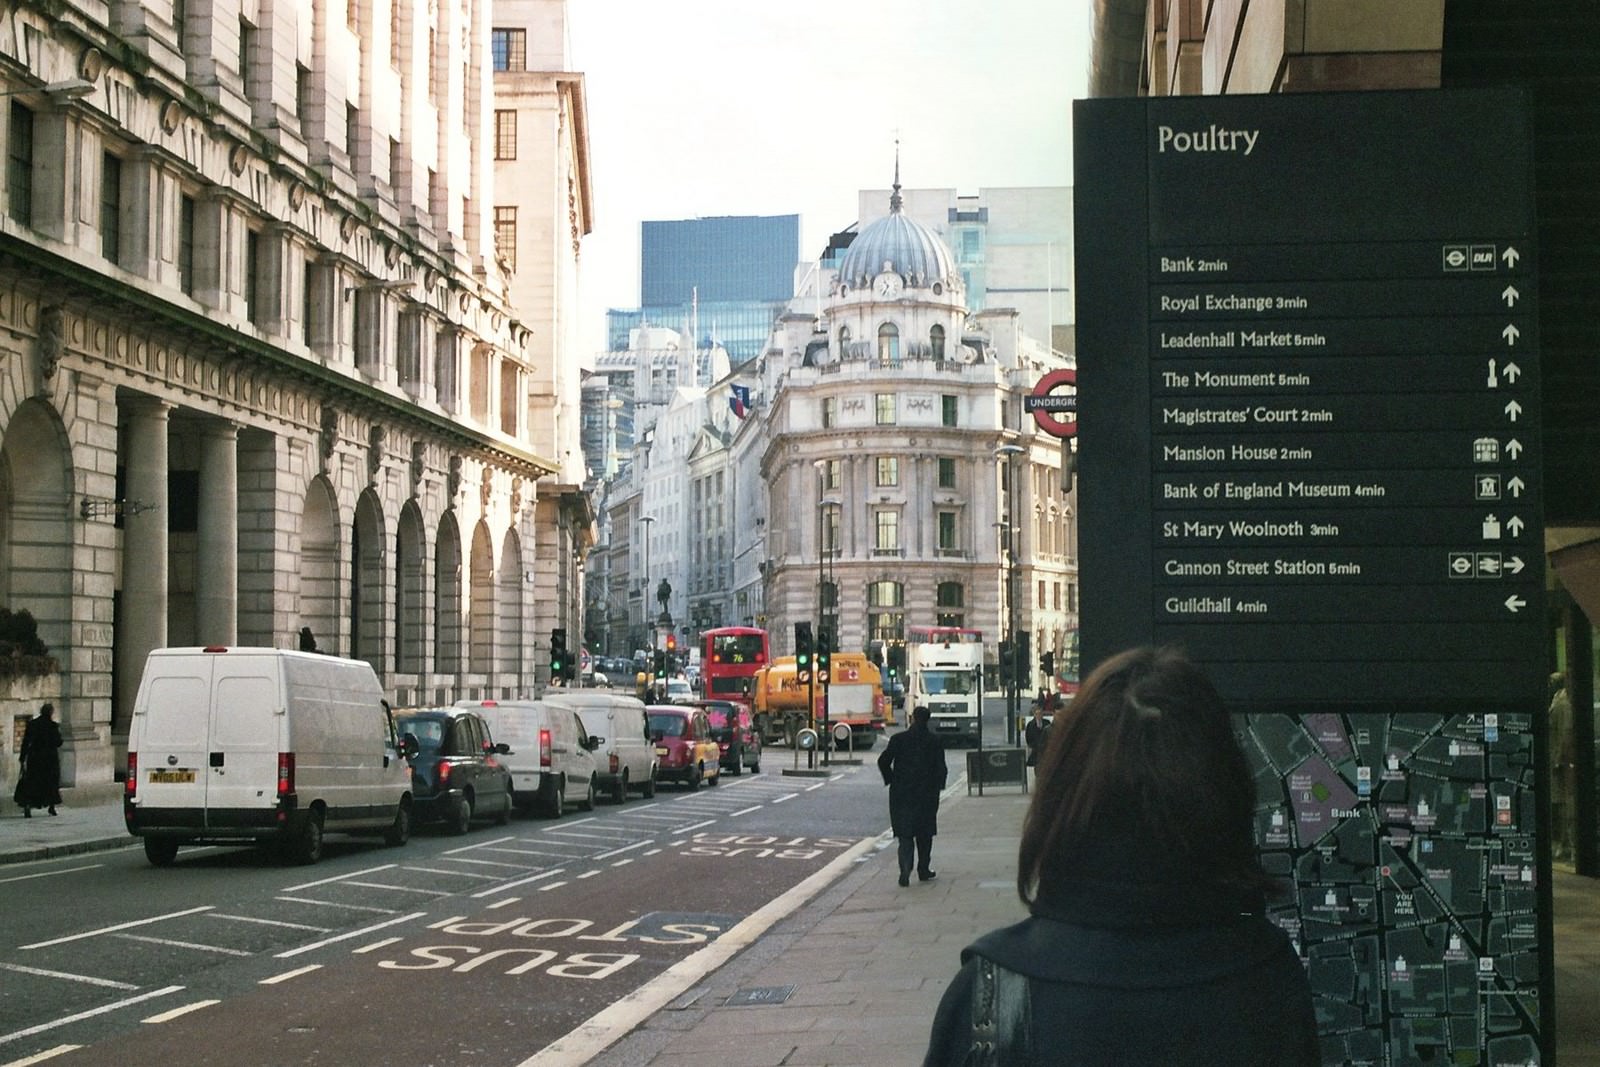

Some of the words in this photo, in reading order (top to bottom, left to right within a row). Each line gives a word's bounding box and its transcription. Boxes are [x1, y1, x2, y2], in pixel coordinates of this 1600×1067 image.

[1158, 124, 1260, 156] Poultry
[1161, 257, 1195, 273] Bank
[1198, 259, 1228, 272] 2min
[1473, 252, 1493, 263] DLR
[1161, 295, 1200, 313] Royal
[1205, 294, 1273, 312] Exchange
[1276, 296, 1308, 309] 3min
[1161, 332, 1235, 349] Leadenhall
[1240, 331, 1293, 347] Market
[1162, 371, 1190, 388] The
[1194, 371, 1276, 387] Monument
[1278, 373, 1310, 386] 5min
[1163, 407, 1251, 426] Magistrates'
[1253, 406, 1299, 423] Court
[1301, 409, 1333, 422] 2min
[1163, 445, 1226, 461] Mansion
[1231, 444, 1278, 461] House
[1280, 447, 1312, 460] 2min
[1163, 482, 1199, 499] Bank
[1203, 481, 1221, 498] of
[1224, 481, 1283, 501] England
[1287, 481, 1351, 498] Museum
[1354, 484, 1386, 497] 4min
[1163, 521, 1179, 538] St
[1183, 521, 1225, 540] Mary
[1228, 520, 1304, 537] Woolnoth
[1310, 523, 1339, 536] 3min
[1164, 560, 1222, 576] Cannon
[1226, 559, 1270, 576] Street
[1274, 558, 1326, 575] Station
[1328, 562, 1361, 575] 5min
[1165, 597, 1232, 614] Guildhall
[1235, 600, 1268, 613] 4min
[733, 654, 743, 663] 76
[1331, 808, 1361, 818] Bank
[693, 836, 857, 847] STOP
[680, 846, 823, 860] BUS
[1394, 907, 1414, 915] HERE
[1513, 908, 1534, 916] STREET
[1416, 918, 1437, 926] STREET
[443, 917, 721, 945] STOP
[378, 945, 641, 980] BUS
